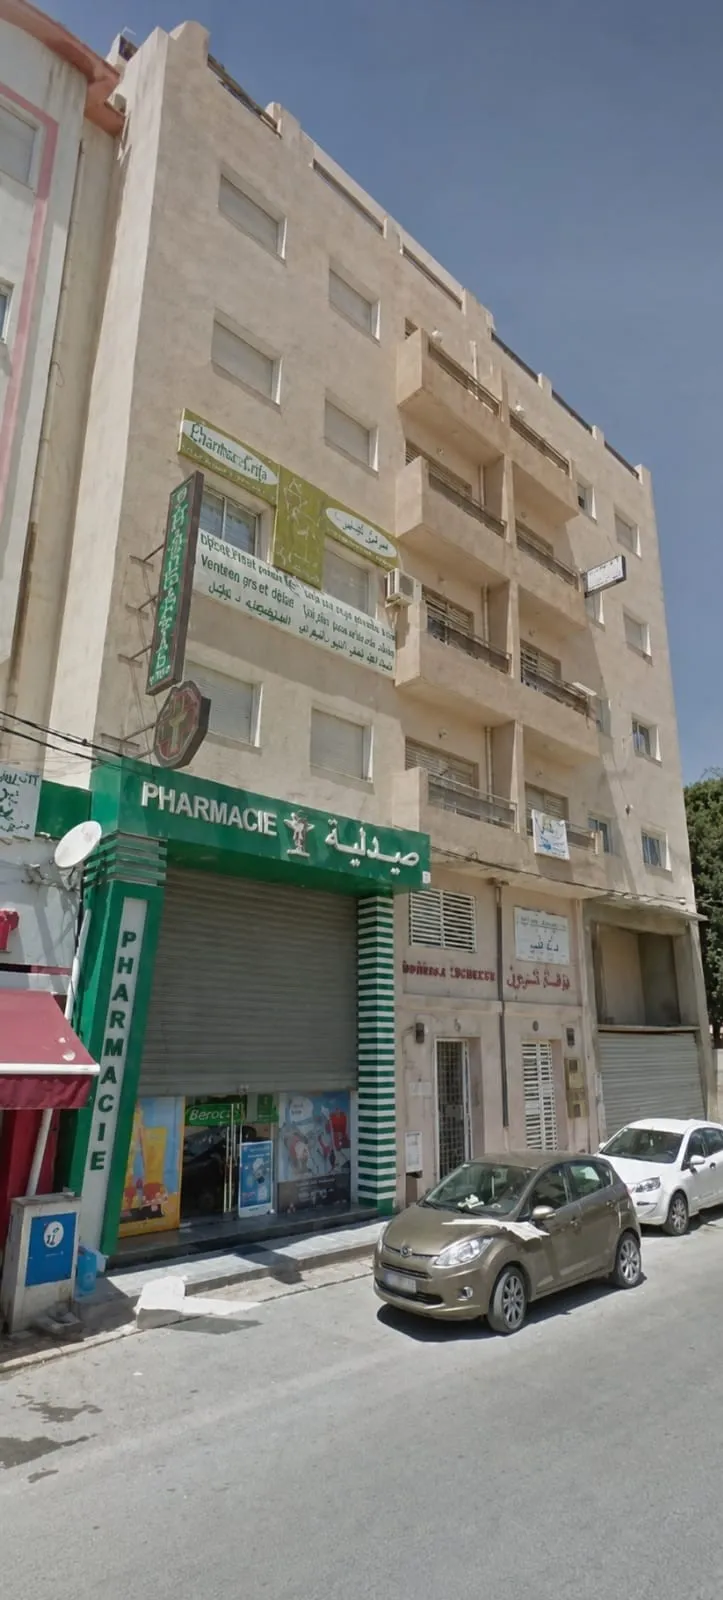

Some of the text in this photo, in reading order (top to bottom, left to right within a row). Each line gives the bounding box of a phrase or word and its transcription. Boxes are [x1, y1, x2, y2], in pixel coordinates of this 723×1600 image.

[141, 781, 278, 837] PHARMACIE
[325, 818, 420, 875] صيدلية
[89, 931, 137, 1171] PHARMACIE
